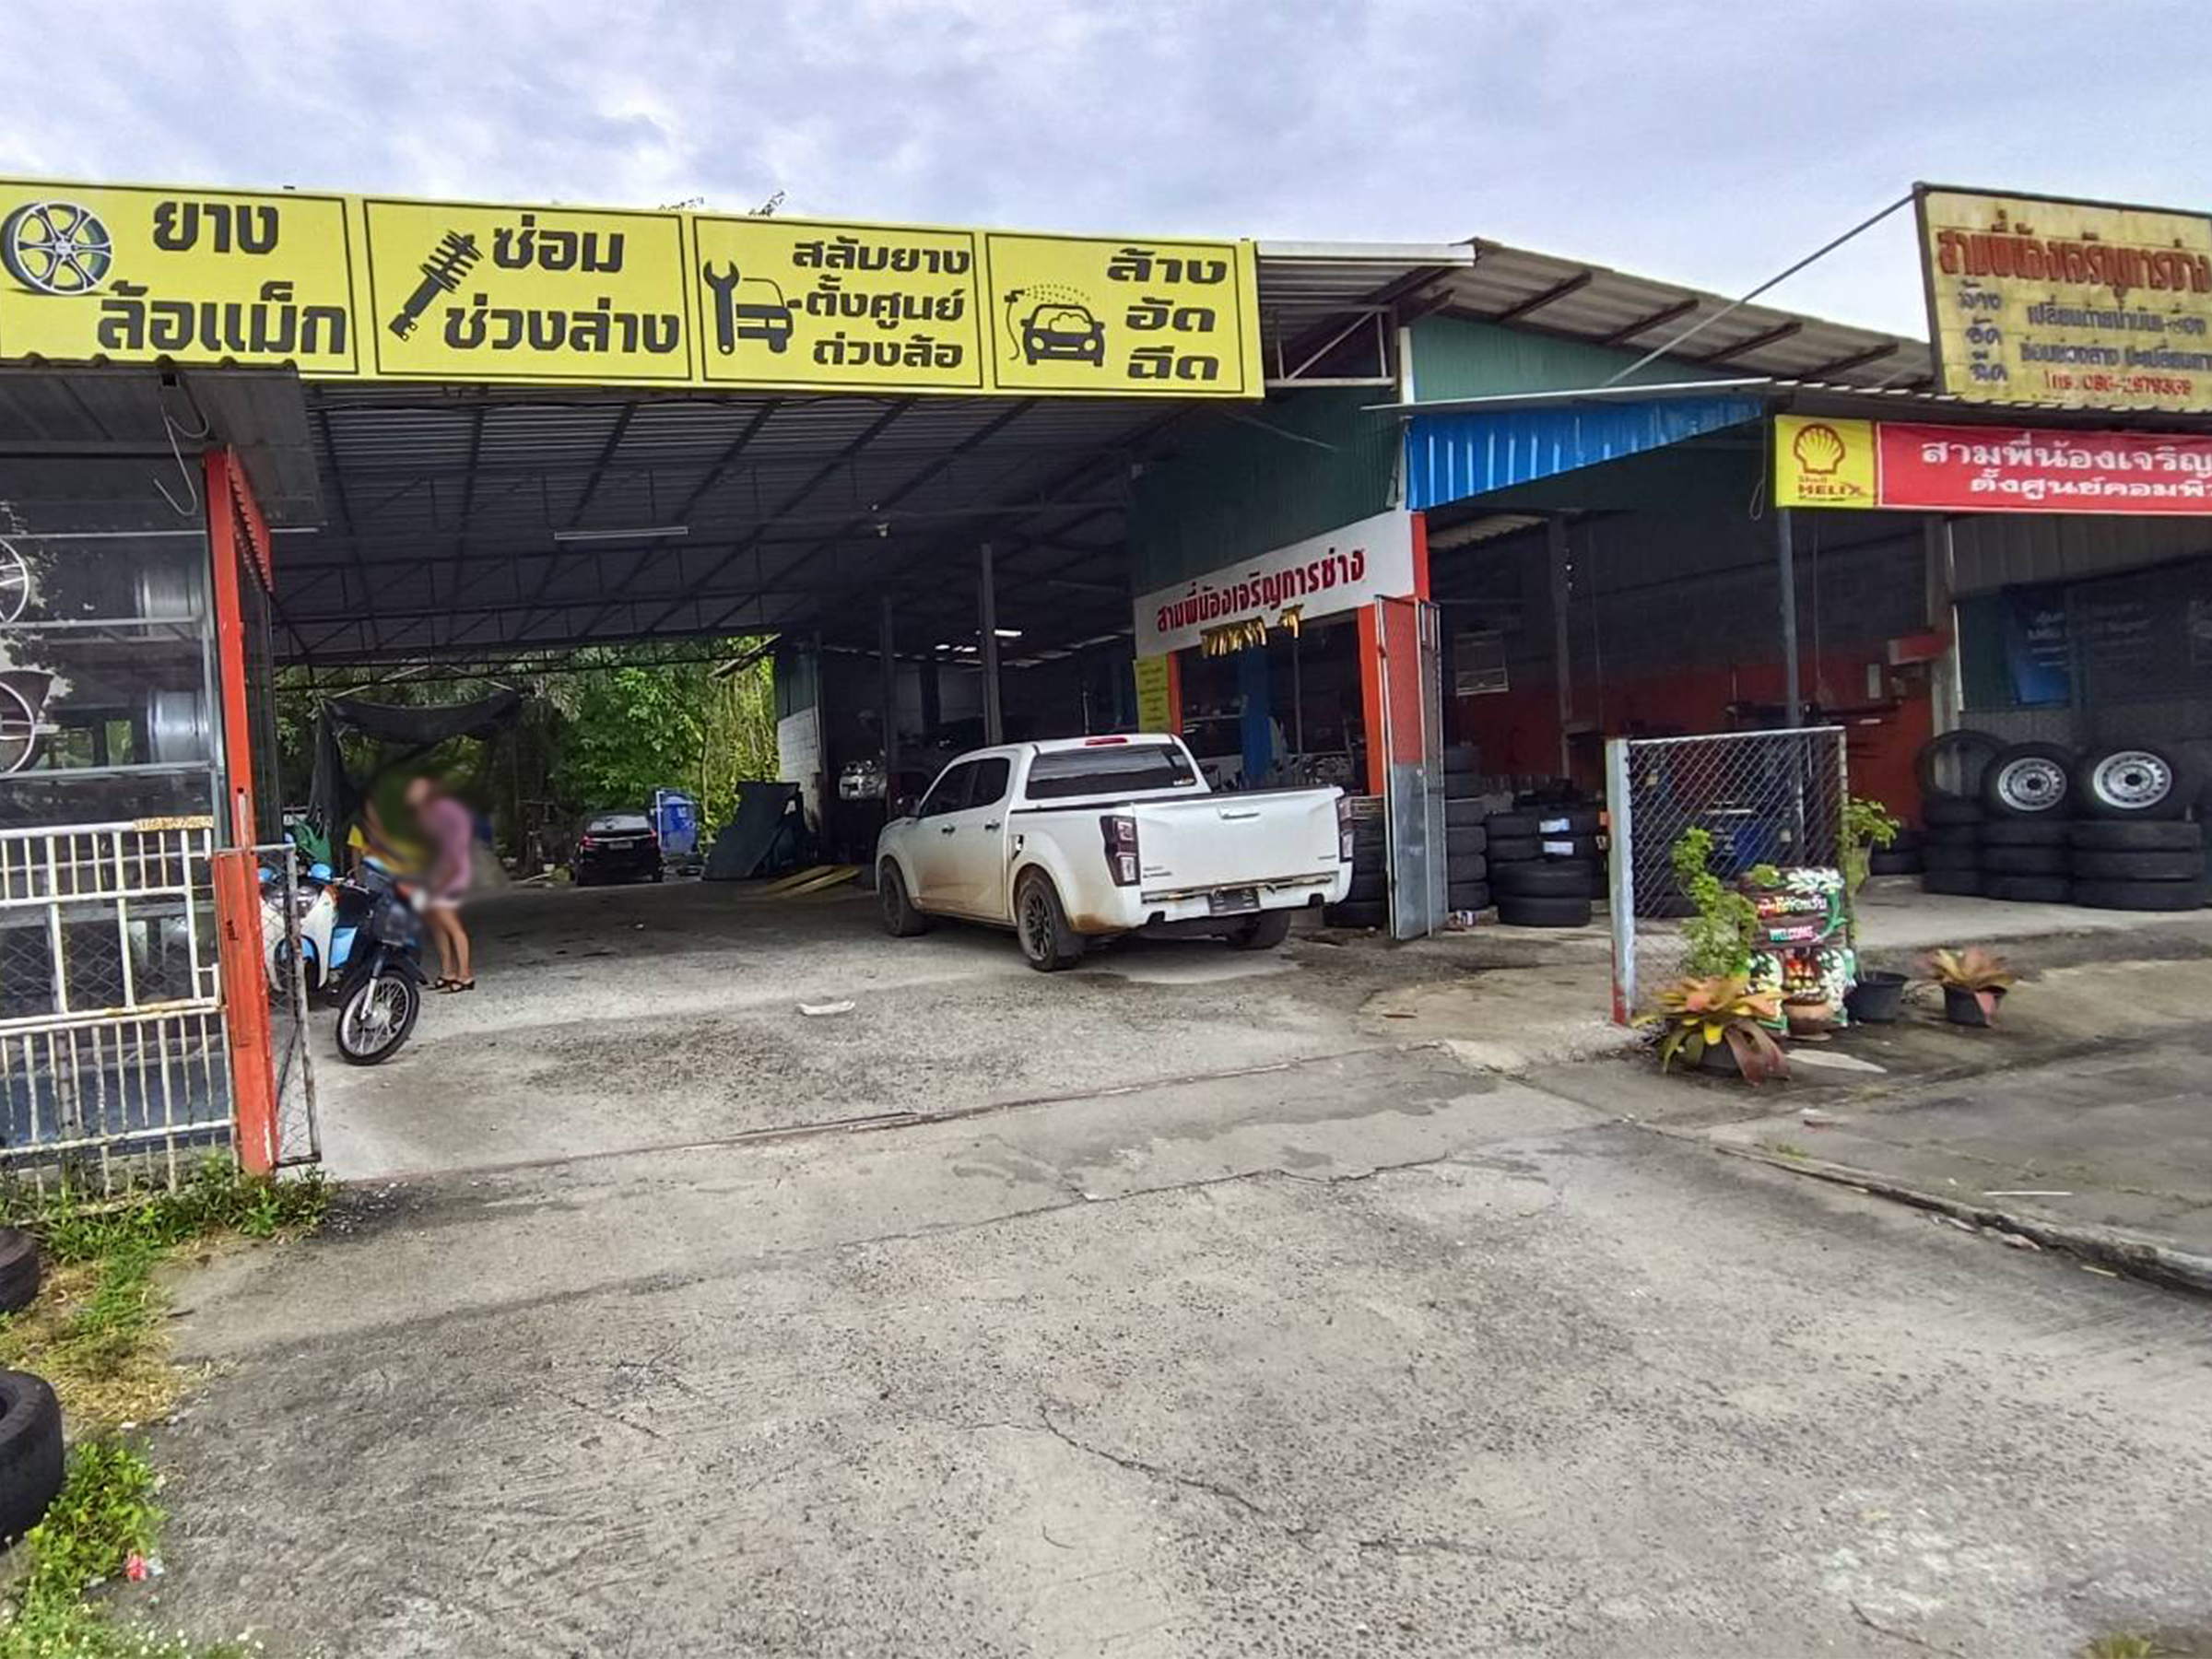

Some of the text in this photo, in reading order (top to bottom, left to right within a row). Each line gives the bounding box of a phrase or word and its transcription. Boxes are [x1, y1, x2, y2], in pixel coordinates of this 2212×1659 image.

[153, 201, 279, 253] ยาง
[493, 214, 625, 273] ซ่อม
[792, 236, 971, 274] สลับยาง
[1106, 247, 1228, 285] ล้าง
[97, 280, 346, 354] ล้อแม็ก
[444, 293, 680, 353] ช่วงล่าง
[805, 275, 966, 329] ตั้งศูนย์
[1125, 296, 1217, 333] อัด
[812, 333, 963, 370] ถ่วงล้อ
[1126, 345, 1220, 381] ฉีด
[1157, 548, 1365, 632] สามพี่น้องเจริญการช่าง
